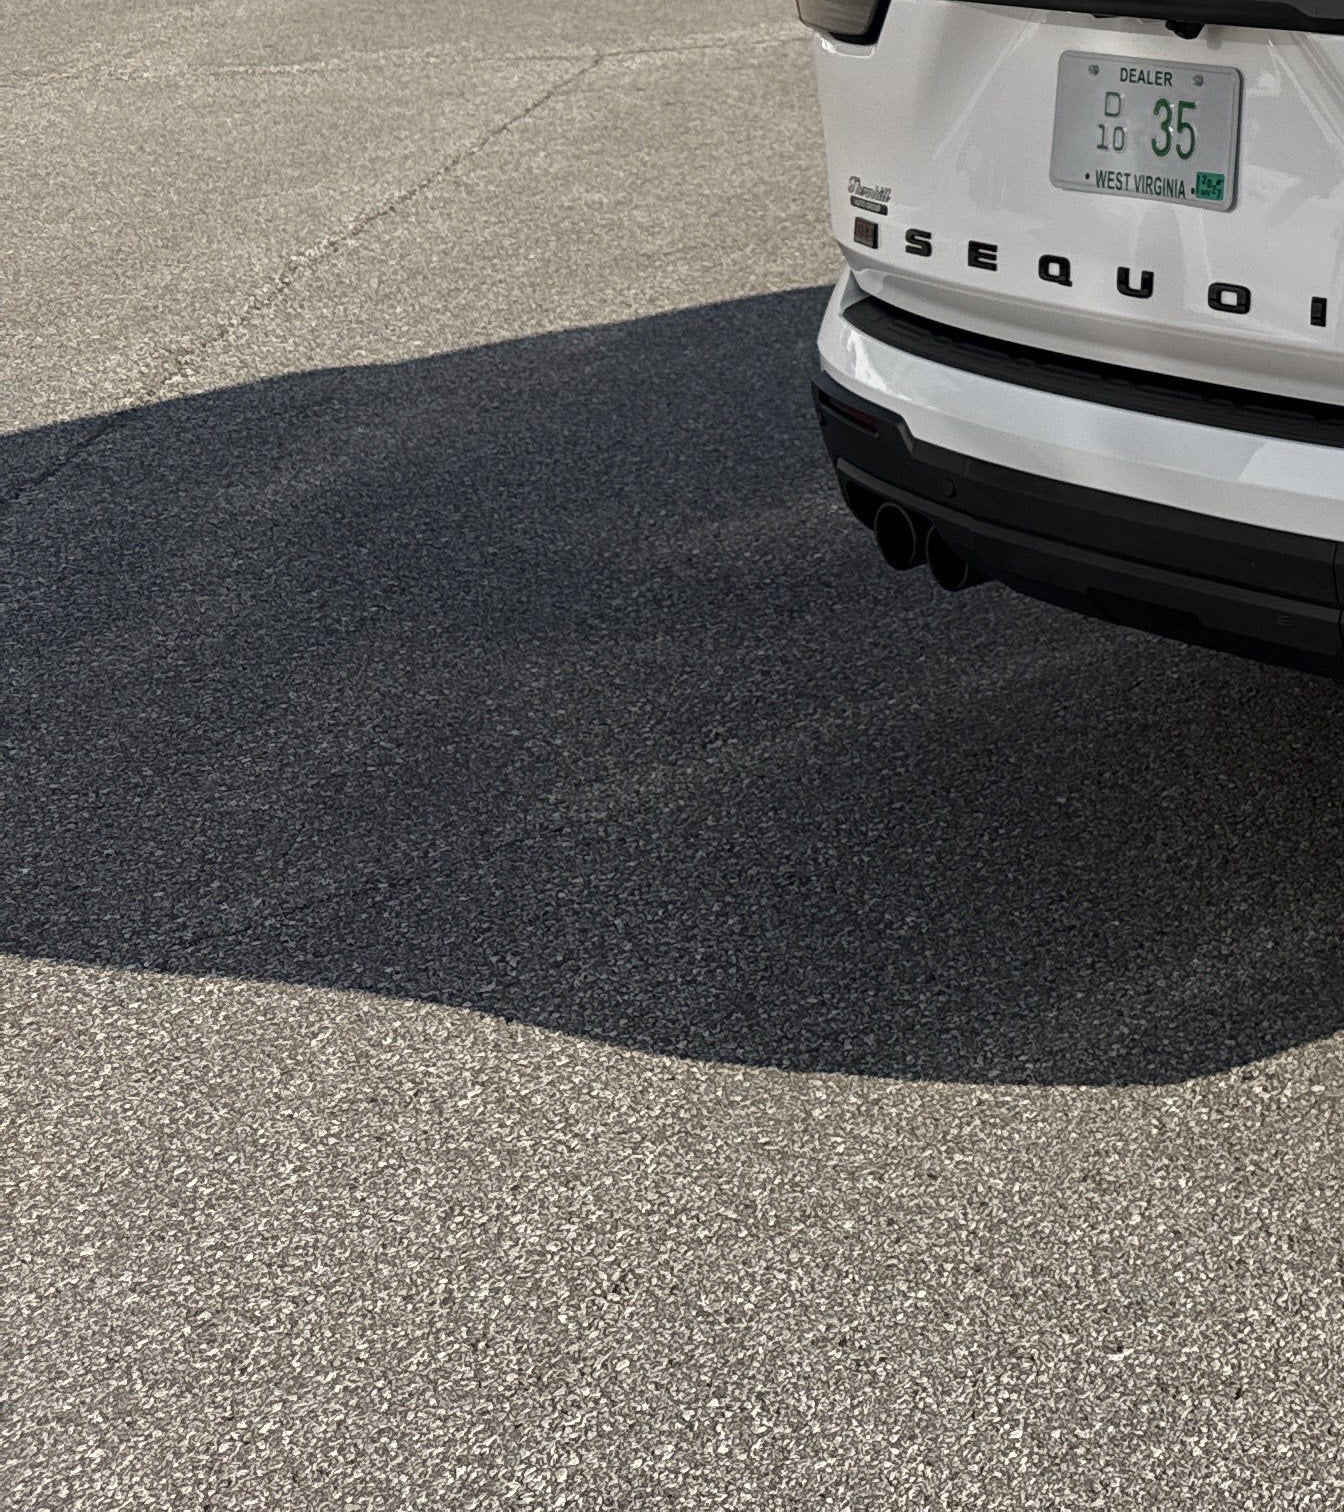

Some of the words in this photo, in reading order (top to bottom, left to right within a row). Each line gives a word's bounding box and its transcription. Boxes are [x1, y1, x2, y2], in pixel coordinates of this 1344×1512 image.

[1119, 67, 1173, 87] DEALER
[1097, 124, 1125, 151] 10
[1151, 98, 1197, 160] 35
[1095, 169, 1131, 191] WEST
[1133, 173, 1187, 199] VIRGINIA
